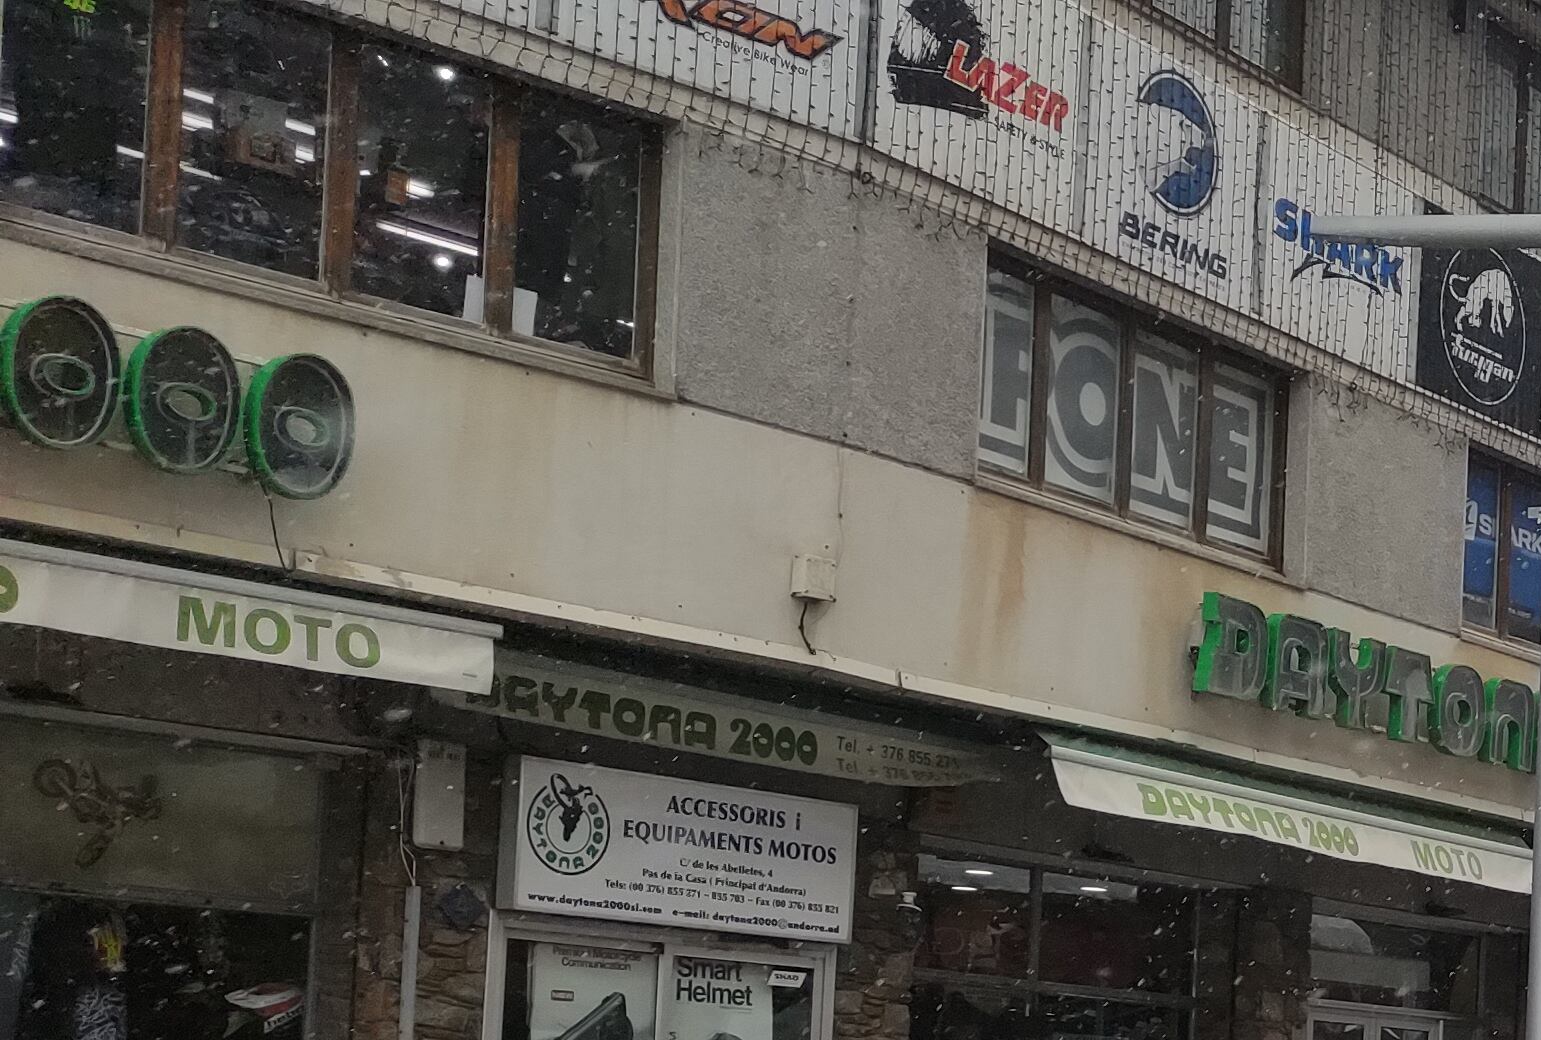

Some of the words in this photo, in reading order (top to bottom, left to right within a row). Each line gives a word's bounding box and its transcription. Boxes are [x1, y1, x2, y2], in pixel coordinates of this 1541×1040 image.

[702, 30, 750, 57] Creative
[753, 50, 777, 66] Bike
[780, 57, 808, 77] Wear
[944, 39, 1069, 134] LAZER
[1120, 210, 1228, 280] BERING
[176, 595, 382, 669] MOTO
[730, 717, 819, 766] 2000
[836, 735, 859, 753] Tel.
[881, 744, 904, 761] 376
[908, 749, 931, 766] 855
[666, 794, 787, 830] ACCESSORIS
[796, 811, 802, 831] i
[1137, 781, 1302, 844] DAYTONA
[1302, 816, 1360, 858] 2000
[1409, 840, 1483, 881] MOTO
[622, 818, 764, 856] EQUIPAMENTS
[767, 840, 838, 865] MOTOS
[605, 878, 627, 890] Tels:
[642, 868, 659, 879] Pas
[660, 870, 672, 881] de
[686, 873, 707, 885] Casa
[692, 860, 704, 869] de
[706, 860, 719, 872] les
[675, 958, 742, 983] Smart
[675, 978, 753, 1006] Helmet
